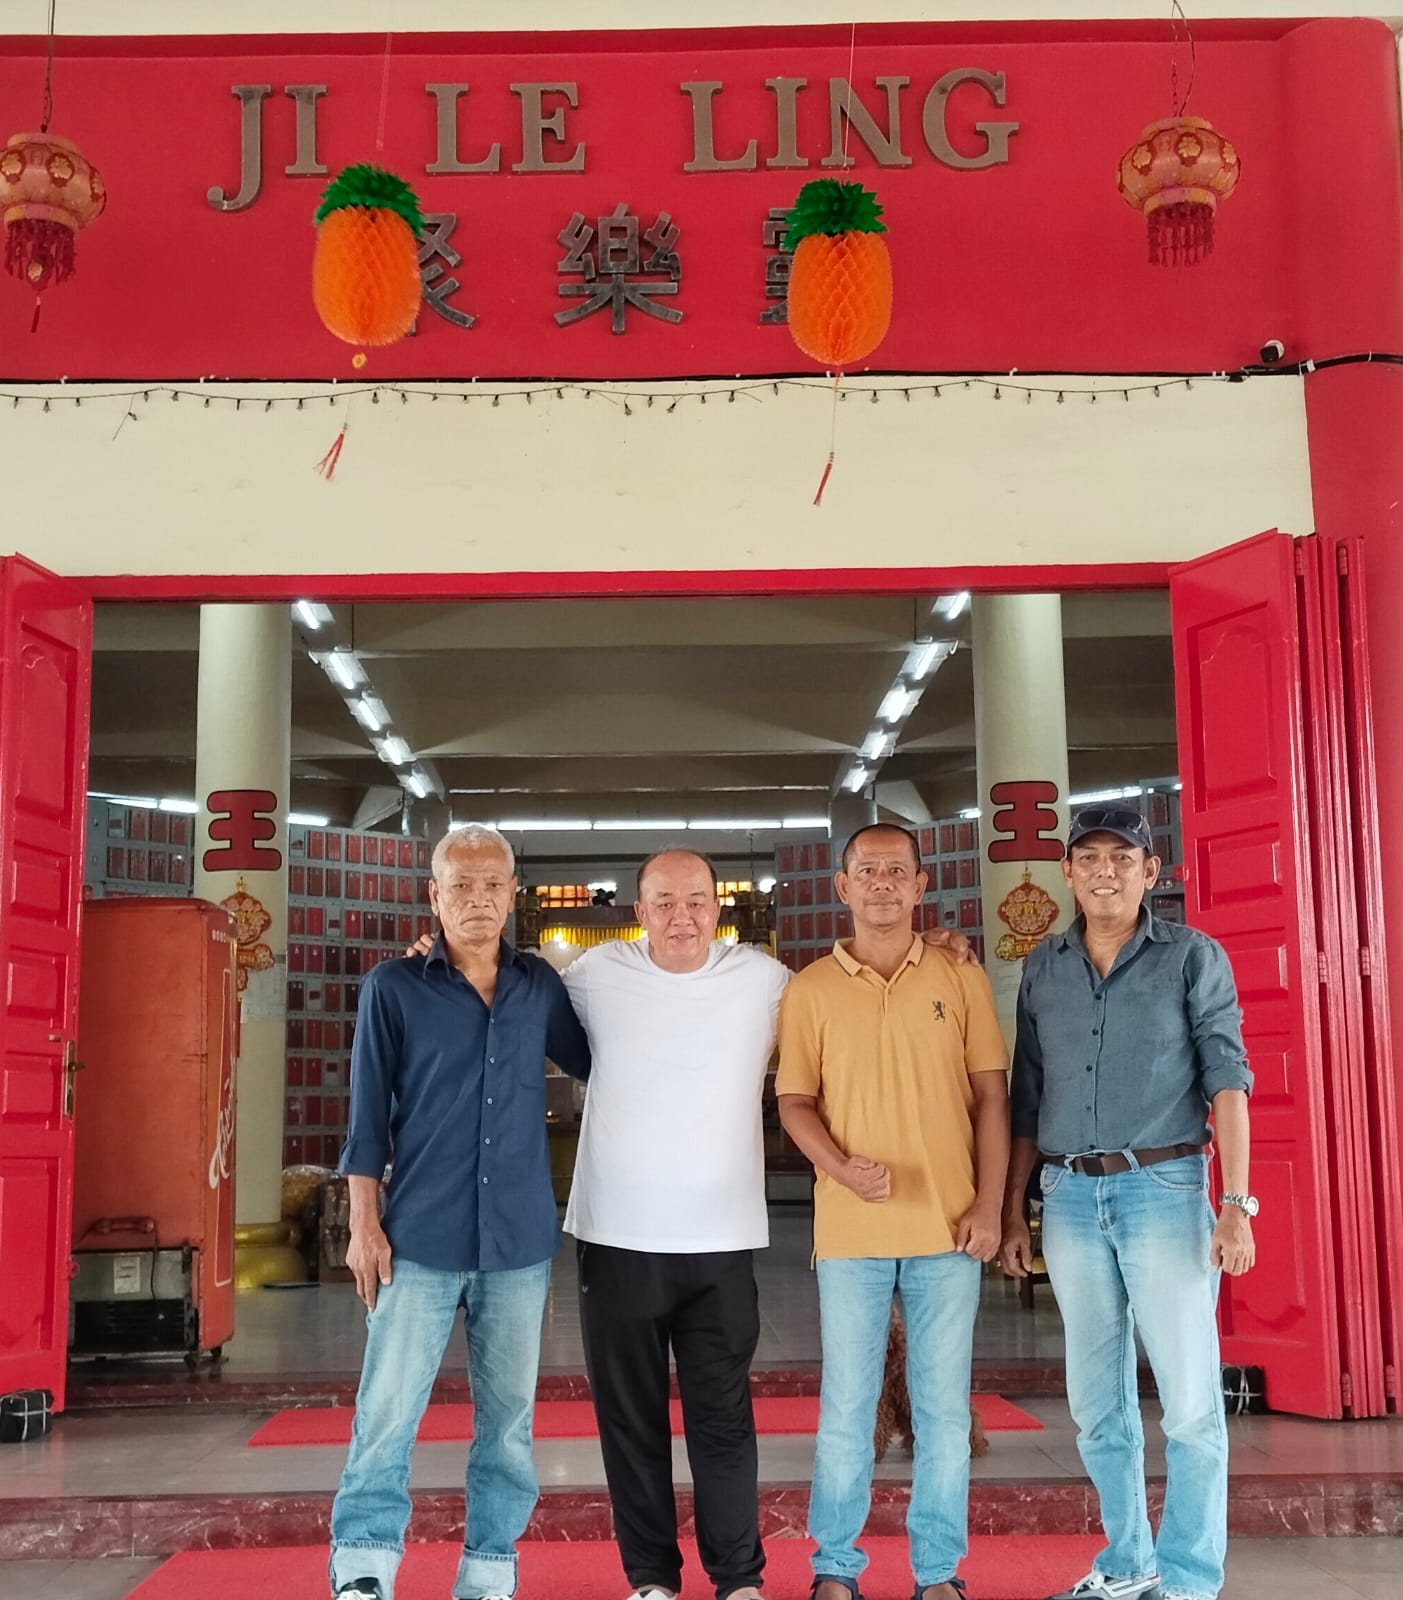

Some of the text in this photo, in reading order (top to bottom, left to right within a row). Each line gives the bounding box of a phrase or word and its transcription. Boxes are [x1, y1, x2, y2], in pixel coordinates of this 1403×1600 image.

[207, 67, 1019, 212] JI LE LING
